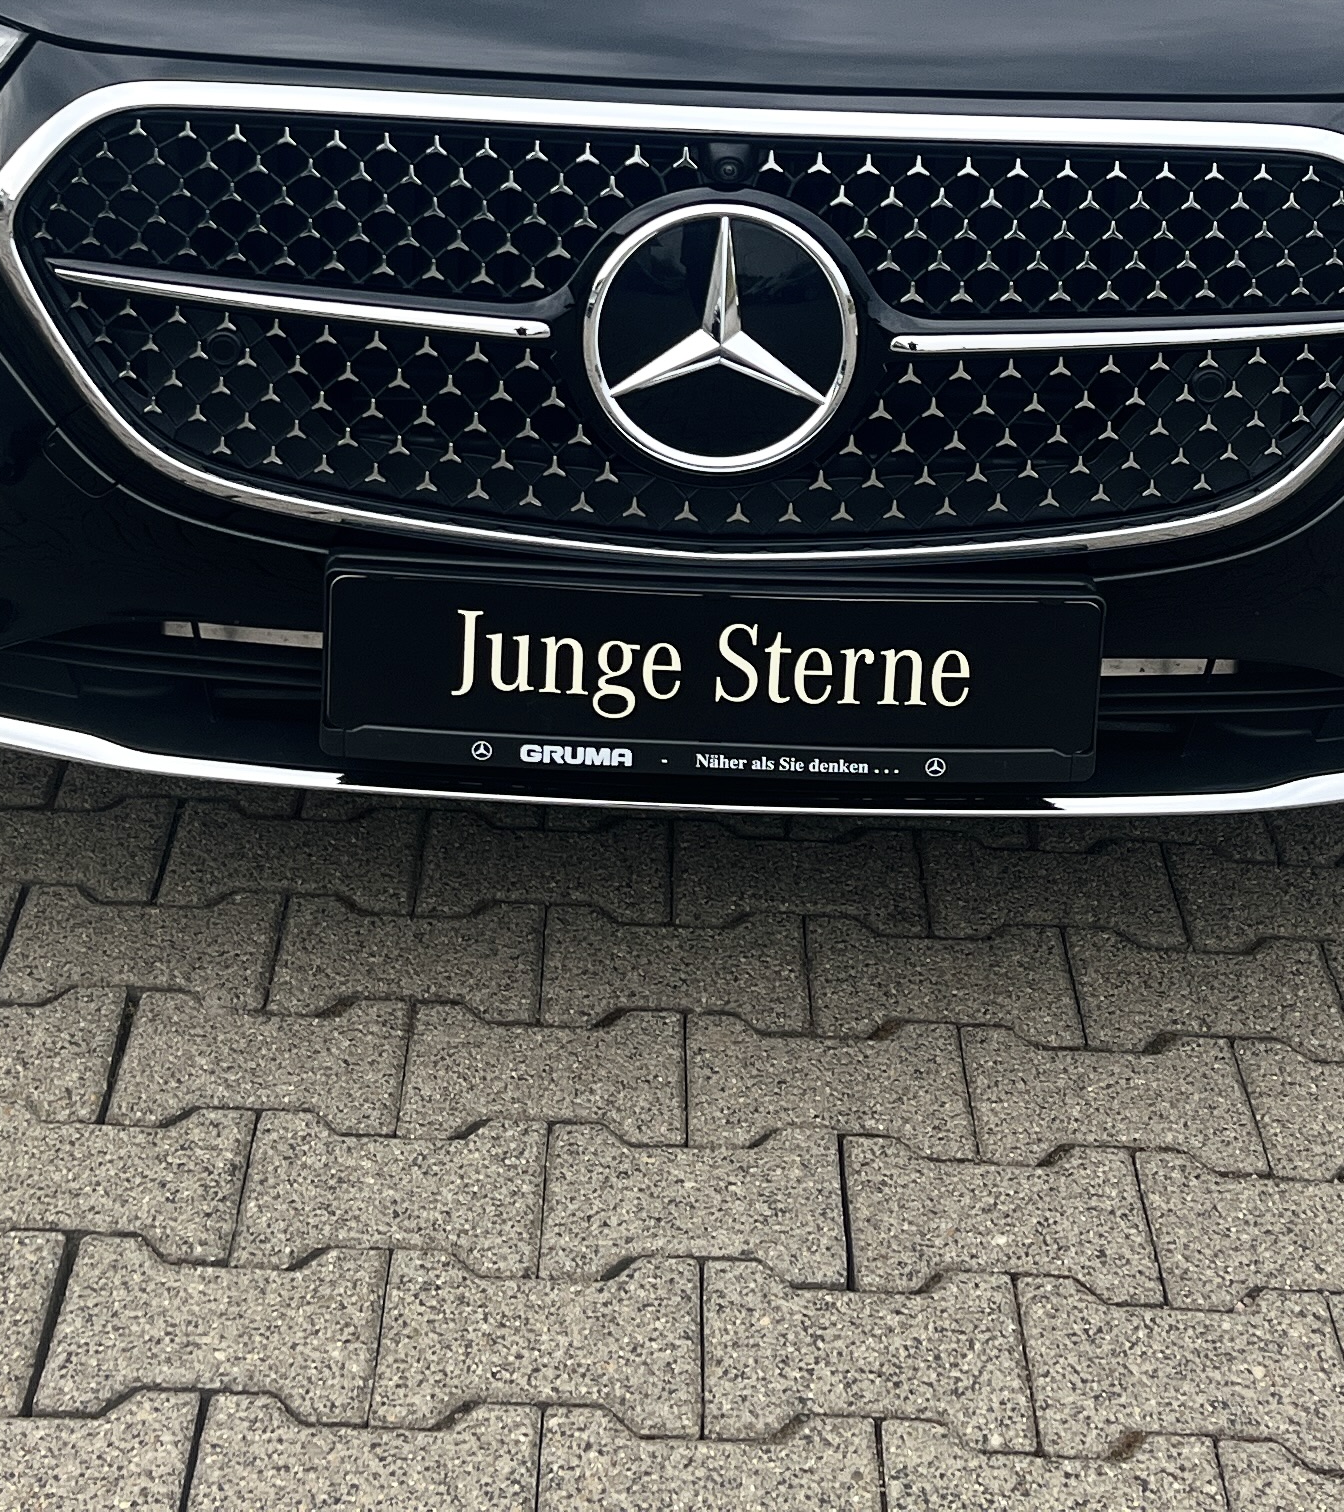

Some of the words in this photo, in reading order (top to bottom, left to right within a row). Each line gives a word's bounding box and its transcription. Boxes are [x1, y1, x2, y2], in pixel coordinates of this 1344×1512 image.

[450, 609, 682, 719] Junge
[714, 623, 970, 707] Sterne
[519, 743, 633, 767] GRUMA
[695, 753, 748, 770] Näher
[751, 756, 775, 771] als
[778, 756, 805, 772] Sie
